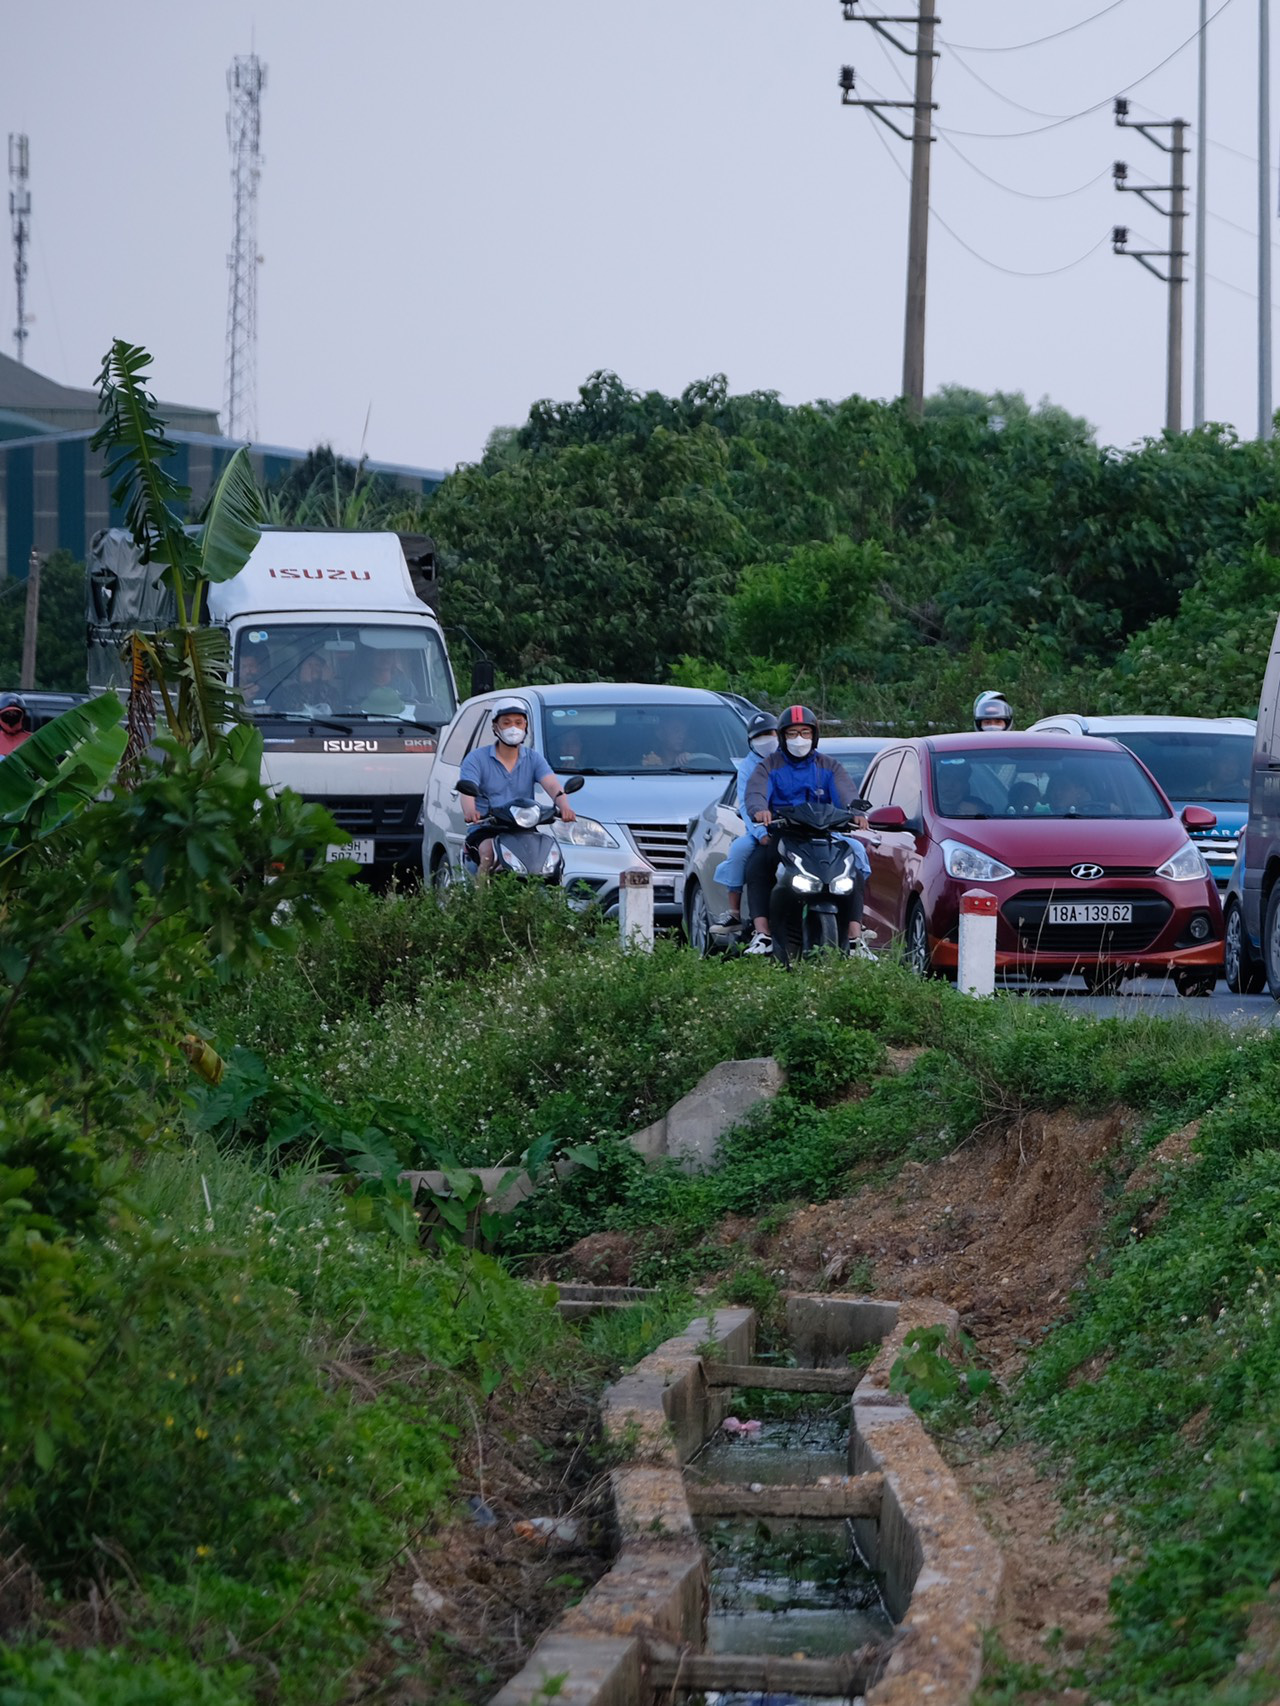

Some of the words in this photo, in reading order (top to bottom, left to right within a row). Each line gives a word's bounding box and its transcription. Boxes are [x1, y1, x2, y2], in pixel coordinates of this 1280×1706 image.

[269, 568, 371, 581] ISUZU
[323, 740, 378, 752] ISUZU
[1052, 905, 1130, 922] 18A-139.62
